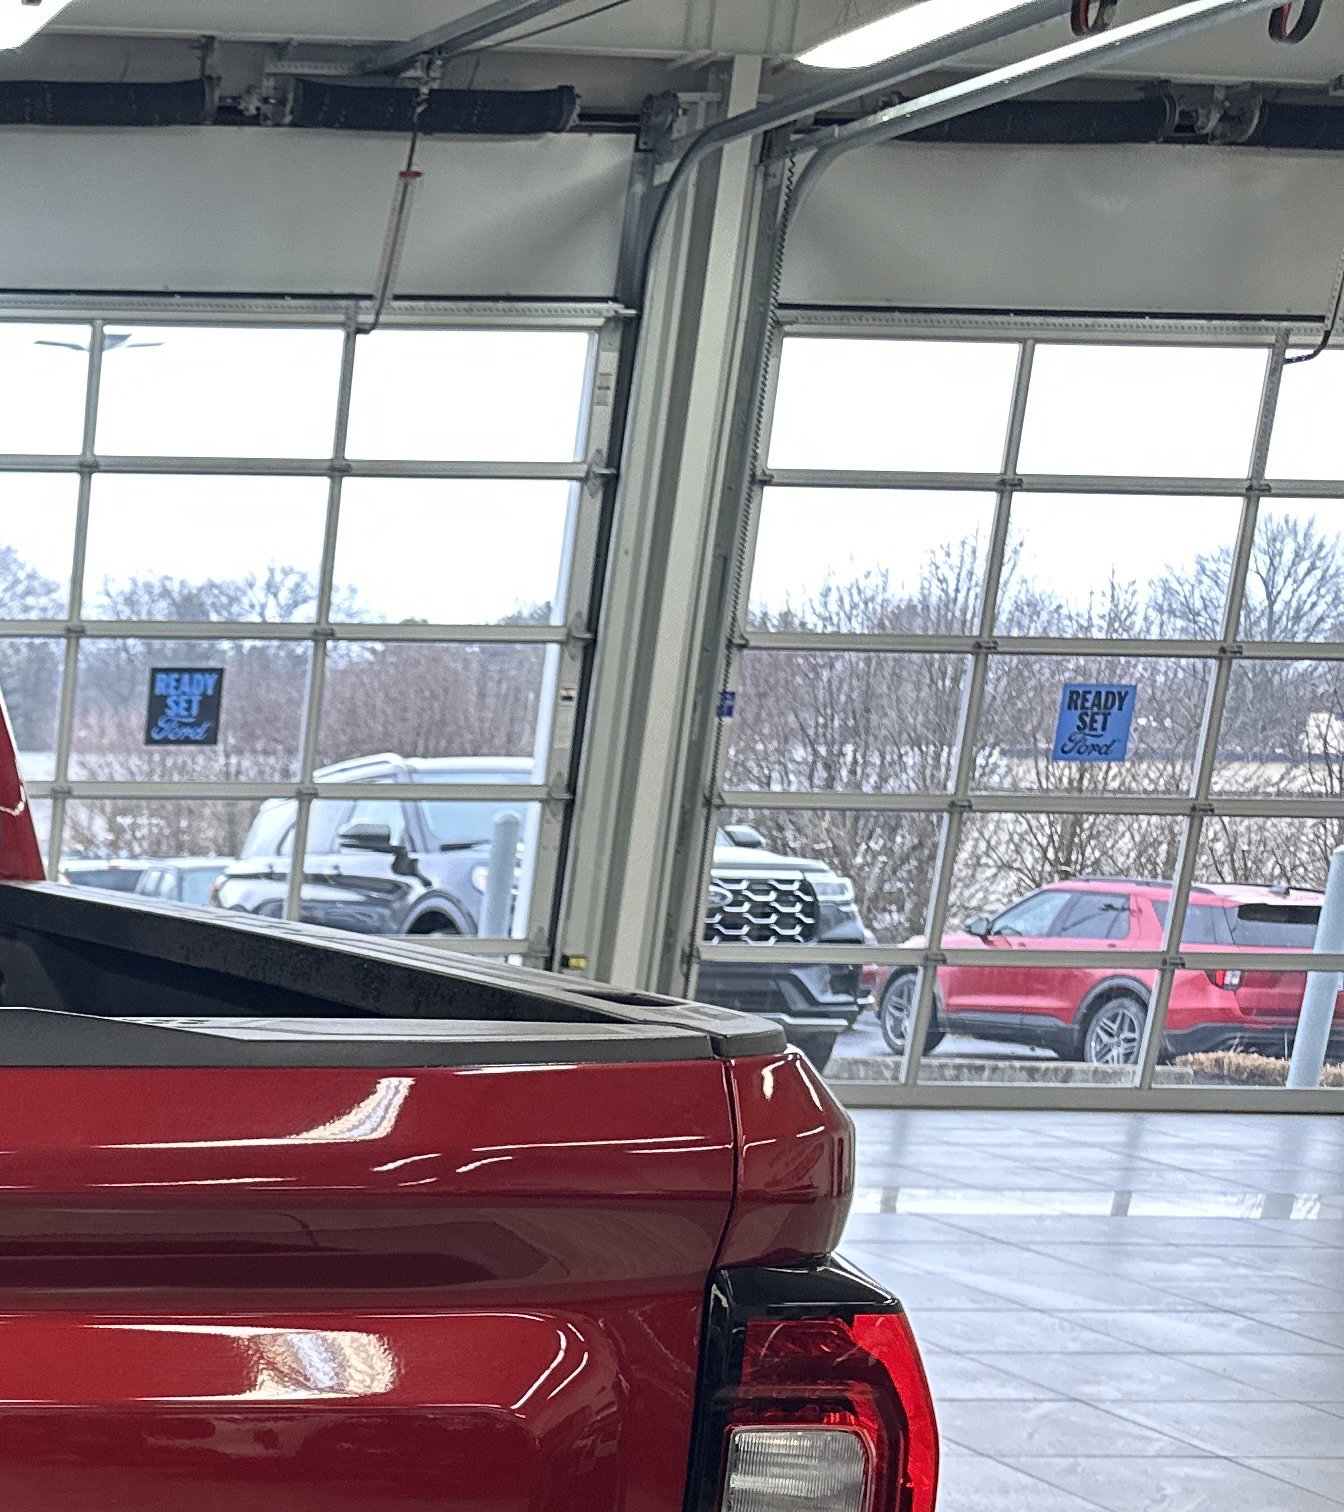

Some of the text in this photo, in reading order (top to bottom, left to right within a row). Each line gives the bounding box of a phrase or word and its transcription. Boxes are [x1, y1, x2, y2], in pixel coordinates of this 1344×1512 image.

[155, 673, 218, 696] READY
[165, 695, 203, 717] SET
[1067, 690, 1129, 711] READY
[150, 715, 213, 740] Ford
[1076, 711, 1112, 732] SET
[1060, 731, 1123, 756] Ford
